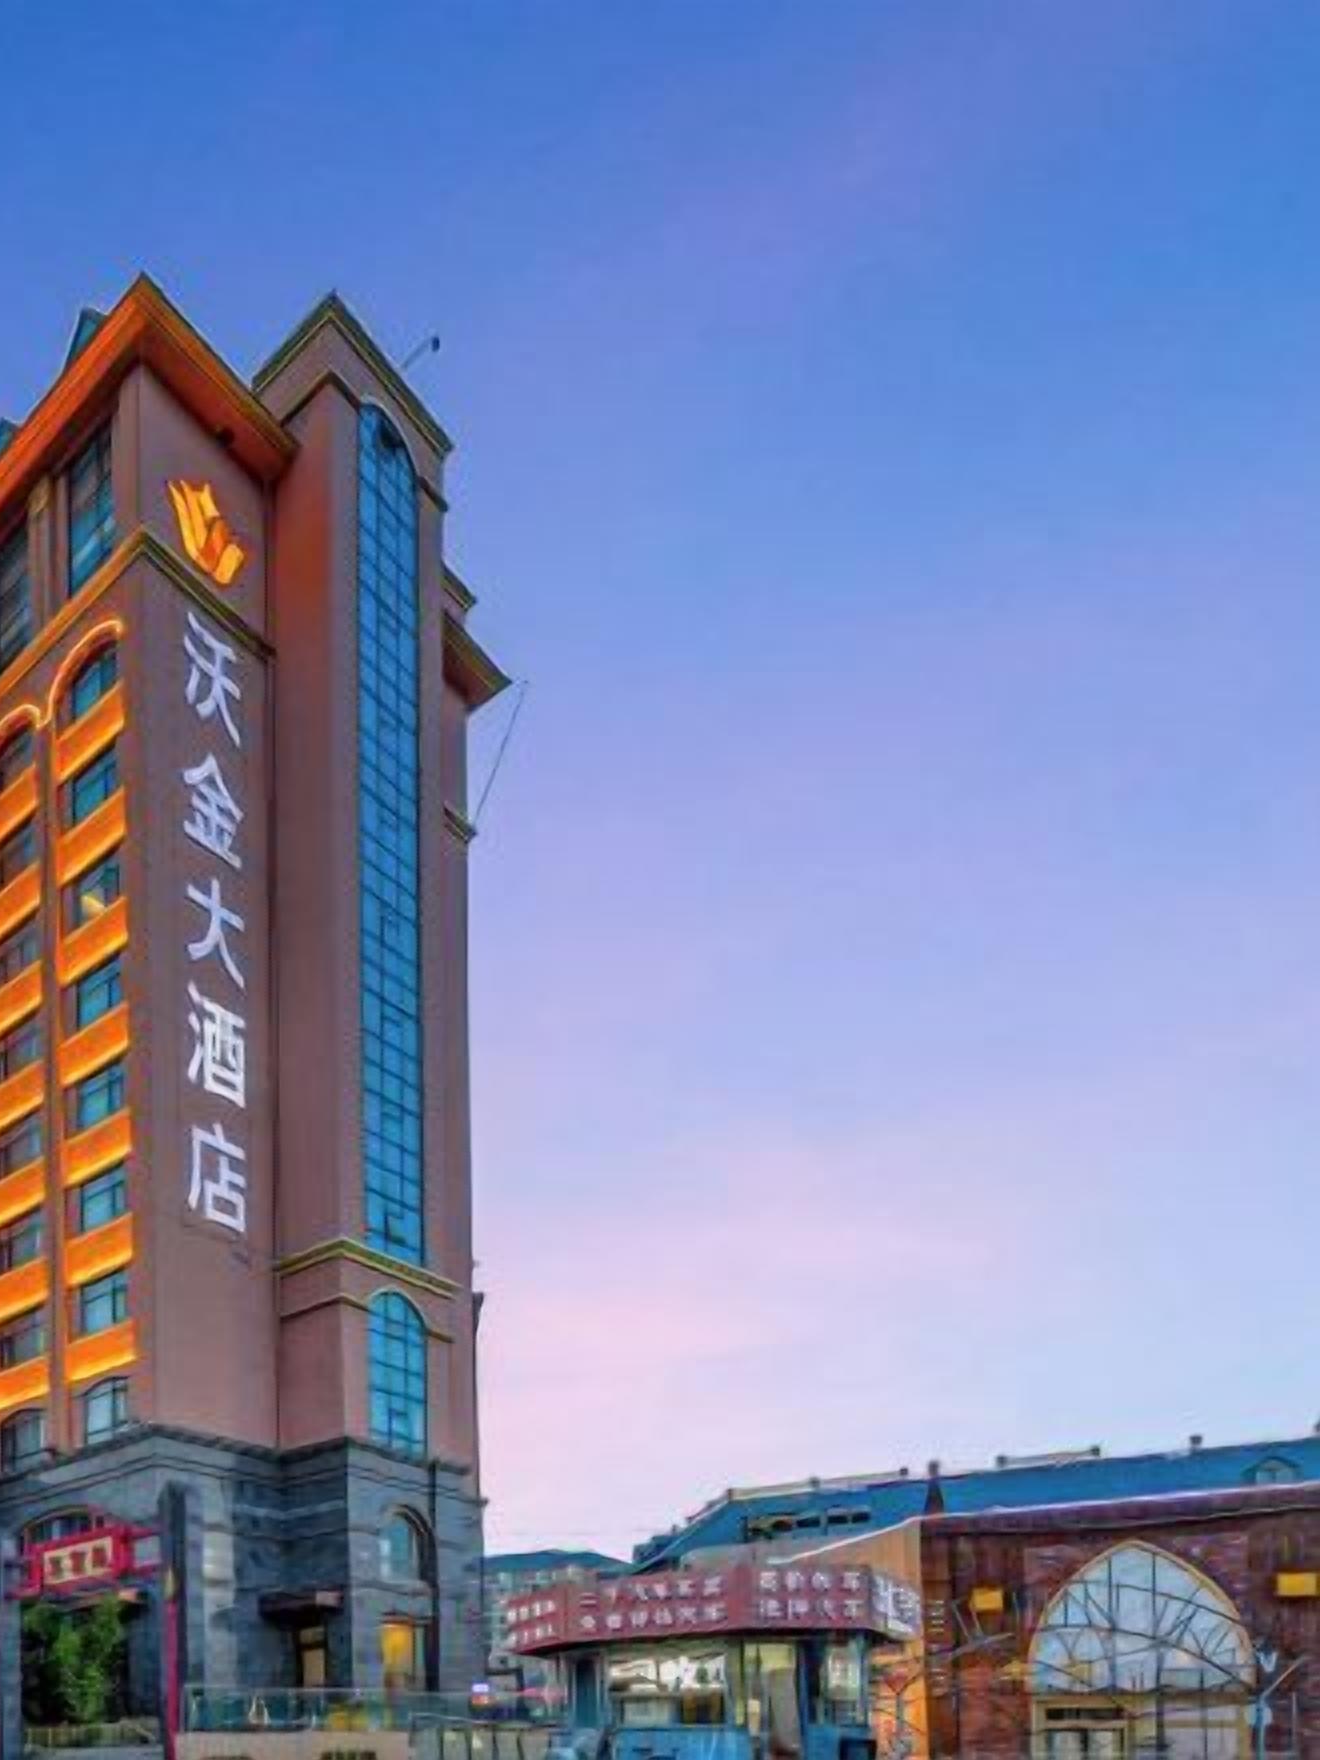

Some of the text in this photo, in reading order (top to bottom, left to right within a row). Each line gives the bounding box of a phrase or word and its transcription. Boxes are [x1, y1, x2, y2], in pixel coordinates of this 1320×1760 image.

[183, 610, 247, 1234] 沃金大酒店
